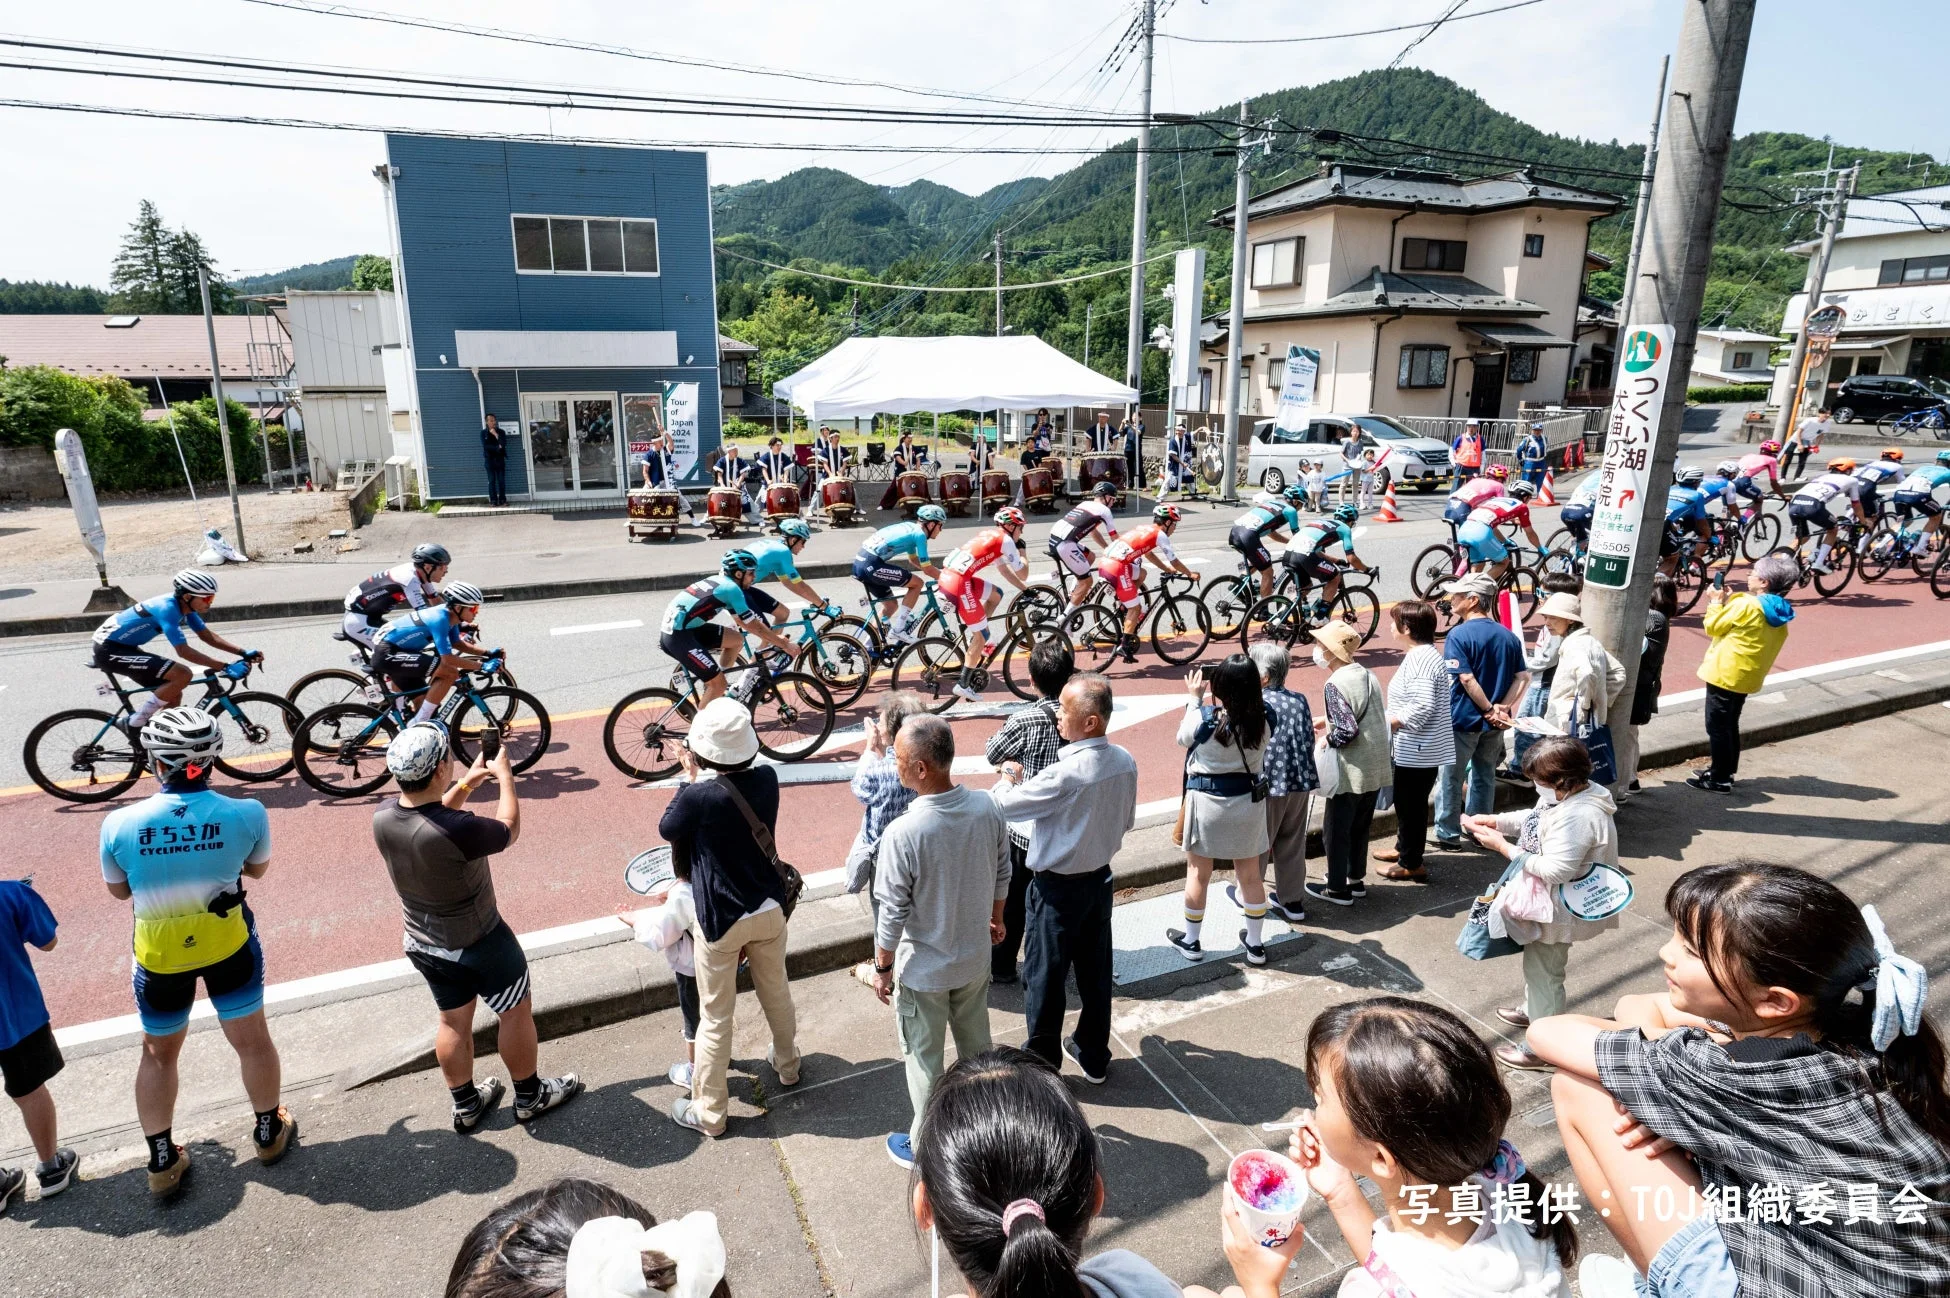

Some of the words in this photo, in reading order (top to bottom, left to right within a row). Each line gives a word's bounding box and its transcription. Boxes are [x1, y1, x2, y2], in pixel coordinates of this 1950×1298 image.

[671, 419, 693, 427] Japan
[1619, 377, 1659, 471] つくい湖
[368, 689, 376, 699] 16
[138, 822, 221, 845] まちさが
[139, 844, 191, 856] CYCLING
[194, 841, 224, 851] CLUB
